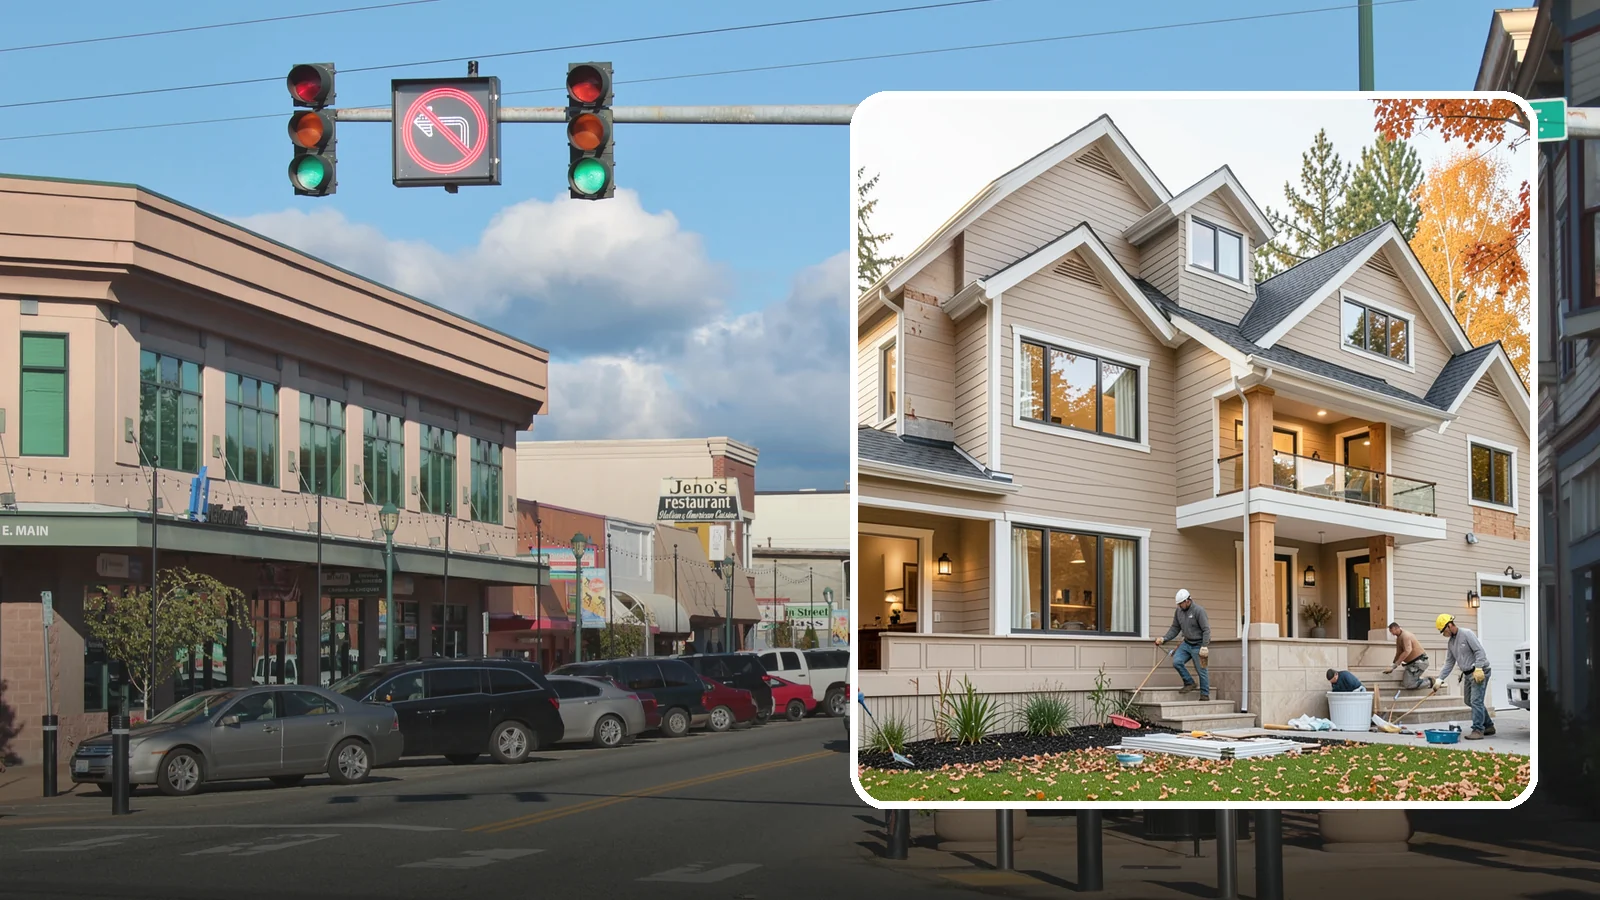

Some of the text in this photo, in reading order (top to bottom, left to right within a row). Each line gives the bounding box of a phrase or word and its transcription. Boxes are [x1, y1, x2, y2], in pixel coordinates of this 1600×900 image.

[670, 480, 728, 494] Jeno's
[665, 496, 731, 509] restaurant
[658, 510, 682, 520] Italian
[686, 509, 714, 519] American
[714, 509, 737, 519] Cuisine
[2, 525, 49, 536] E. MAIN
[797, 607, 828, 617] Street
[791, 619, 824, 627] lass
